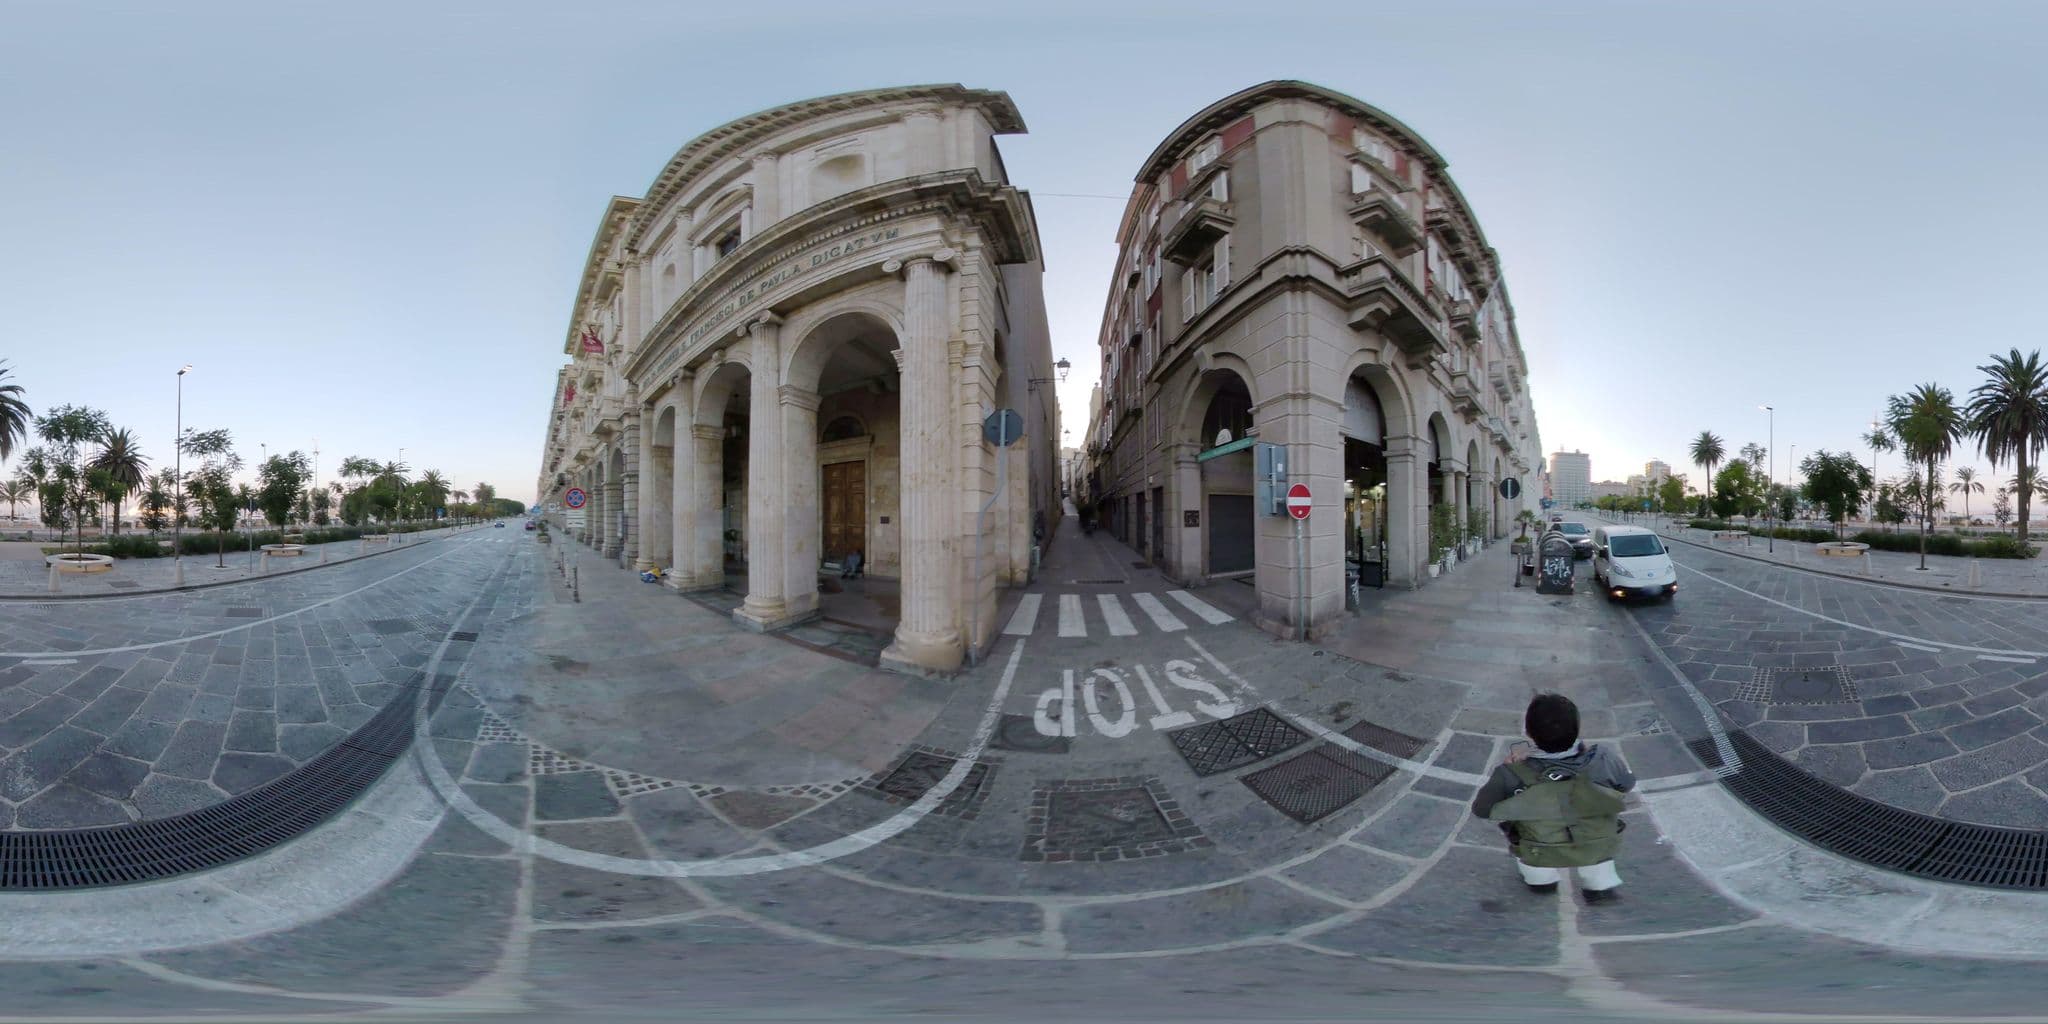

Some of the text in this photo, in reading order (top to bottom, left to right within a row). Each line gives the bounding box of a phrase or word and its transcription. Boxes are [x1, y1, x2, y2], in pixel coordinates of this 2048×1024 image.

[739, 290, 754, 306] DE
[760, 264, 801, 292] PAVLA
[812, 228, 899, 267] DICATVM
[1034, 659, 1237, 739] STOP
